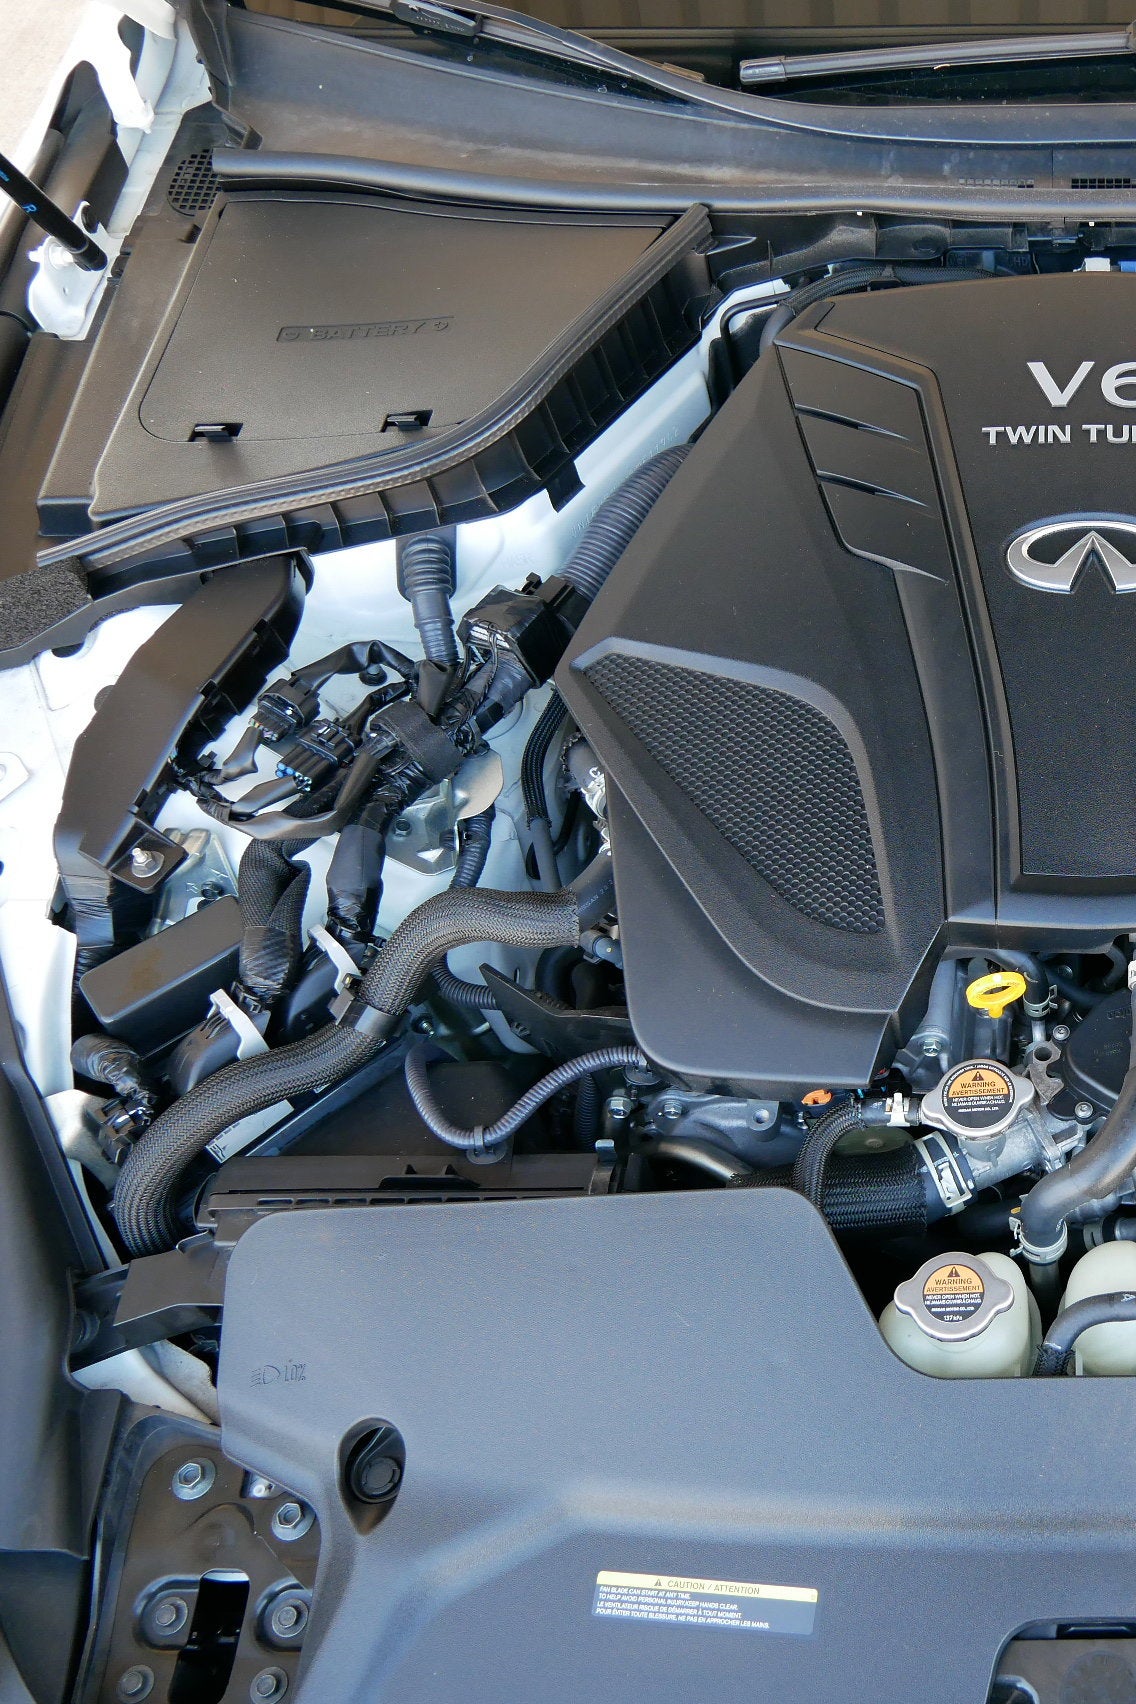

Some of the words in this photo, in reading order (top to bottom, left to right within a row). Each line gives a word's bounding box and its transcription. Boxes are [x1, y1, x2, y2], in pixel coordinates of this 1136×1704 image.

[981, 424, 1072, 446] TWIN
[951, 1087, 1005, 1096] AVERTISSEMENT
[960, 1081, 996, 1089] WARNING
[934, 1277, 973, 1286] WARNING
[926, 1285, 981, 1293] AVERTISSEMENT
[667, 1580, 705, 1591] CAUTION
[714, 1584, 760, 1595] ATTENTION
[605, 1602, 639, 1610] VENTILATEUR
[667, 1605, 698, 1615] DÉMARRER
[637, 1596, 666, 1604] PERSONAL
[700, 1601, 720, 1609] HANDS
[612, 1608, 631, 1616] ÉVITER
[631, 1610, 648, 1618] TOUTE
[706, 1617, 740, 1626] APPROCHER
